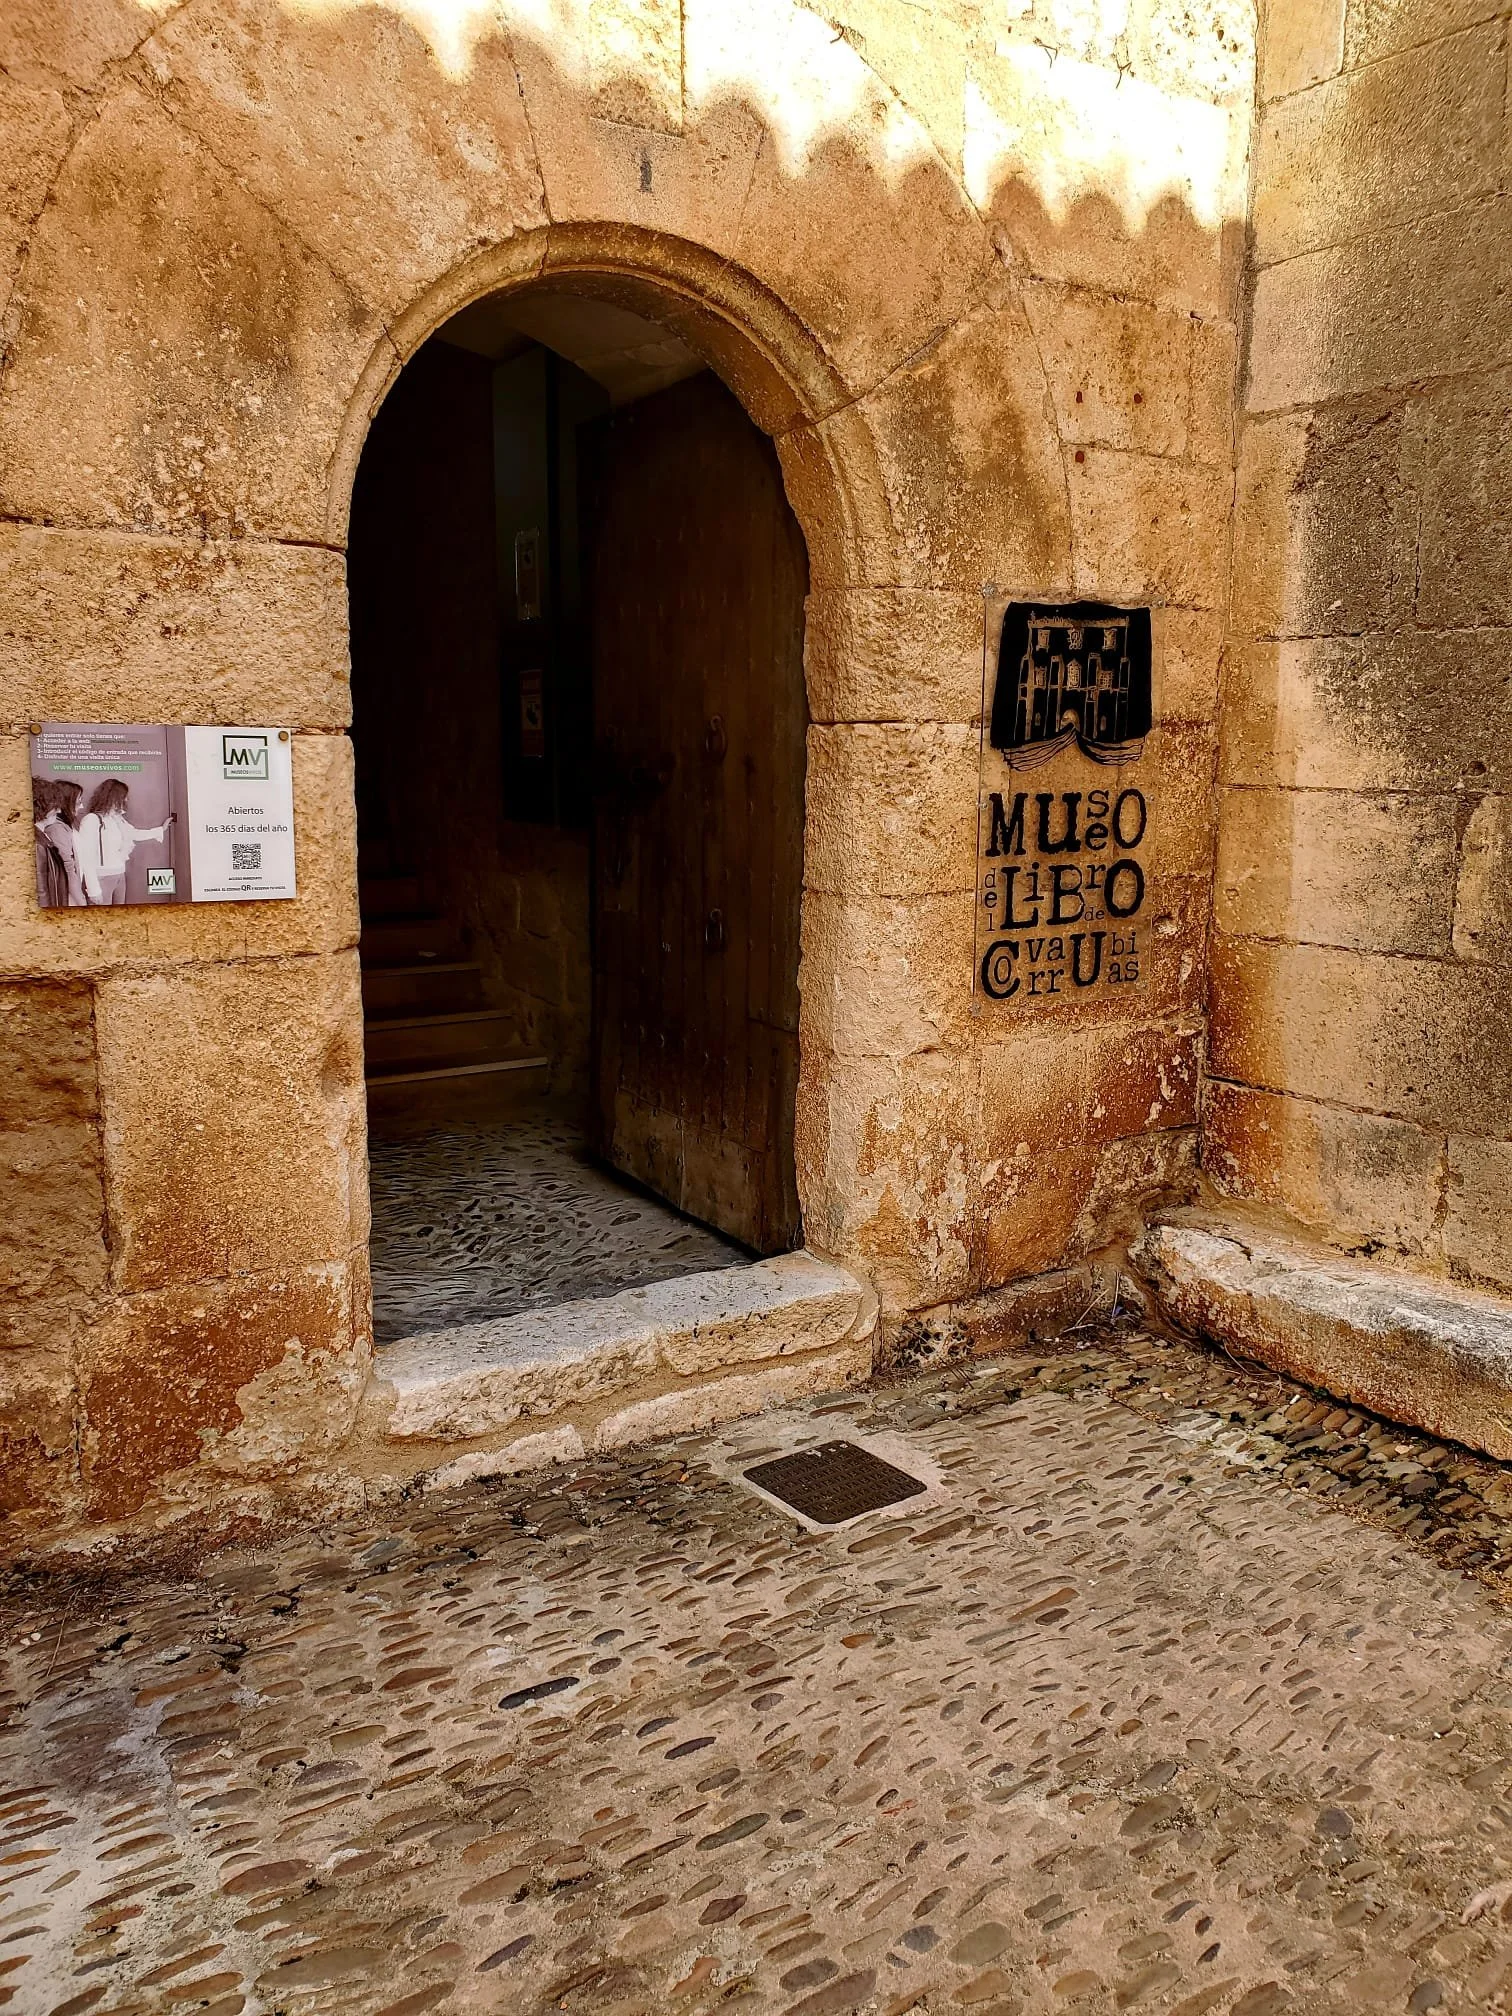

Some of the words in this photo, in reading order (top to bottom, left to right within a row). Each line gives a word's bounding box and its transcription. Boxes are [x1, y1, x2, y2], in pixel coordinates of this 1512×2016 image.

[53, 764, 140, 772] www.museosvivos.com
[228, 806, 264, 815] Abiertos
[205, 824, 219, 833] los
[220, 824, 236, 833] 365
[256, 823, 270, 833] del
[271, 824, 288, 832] año
[241, 884, 252, 892] QR
